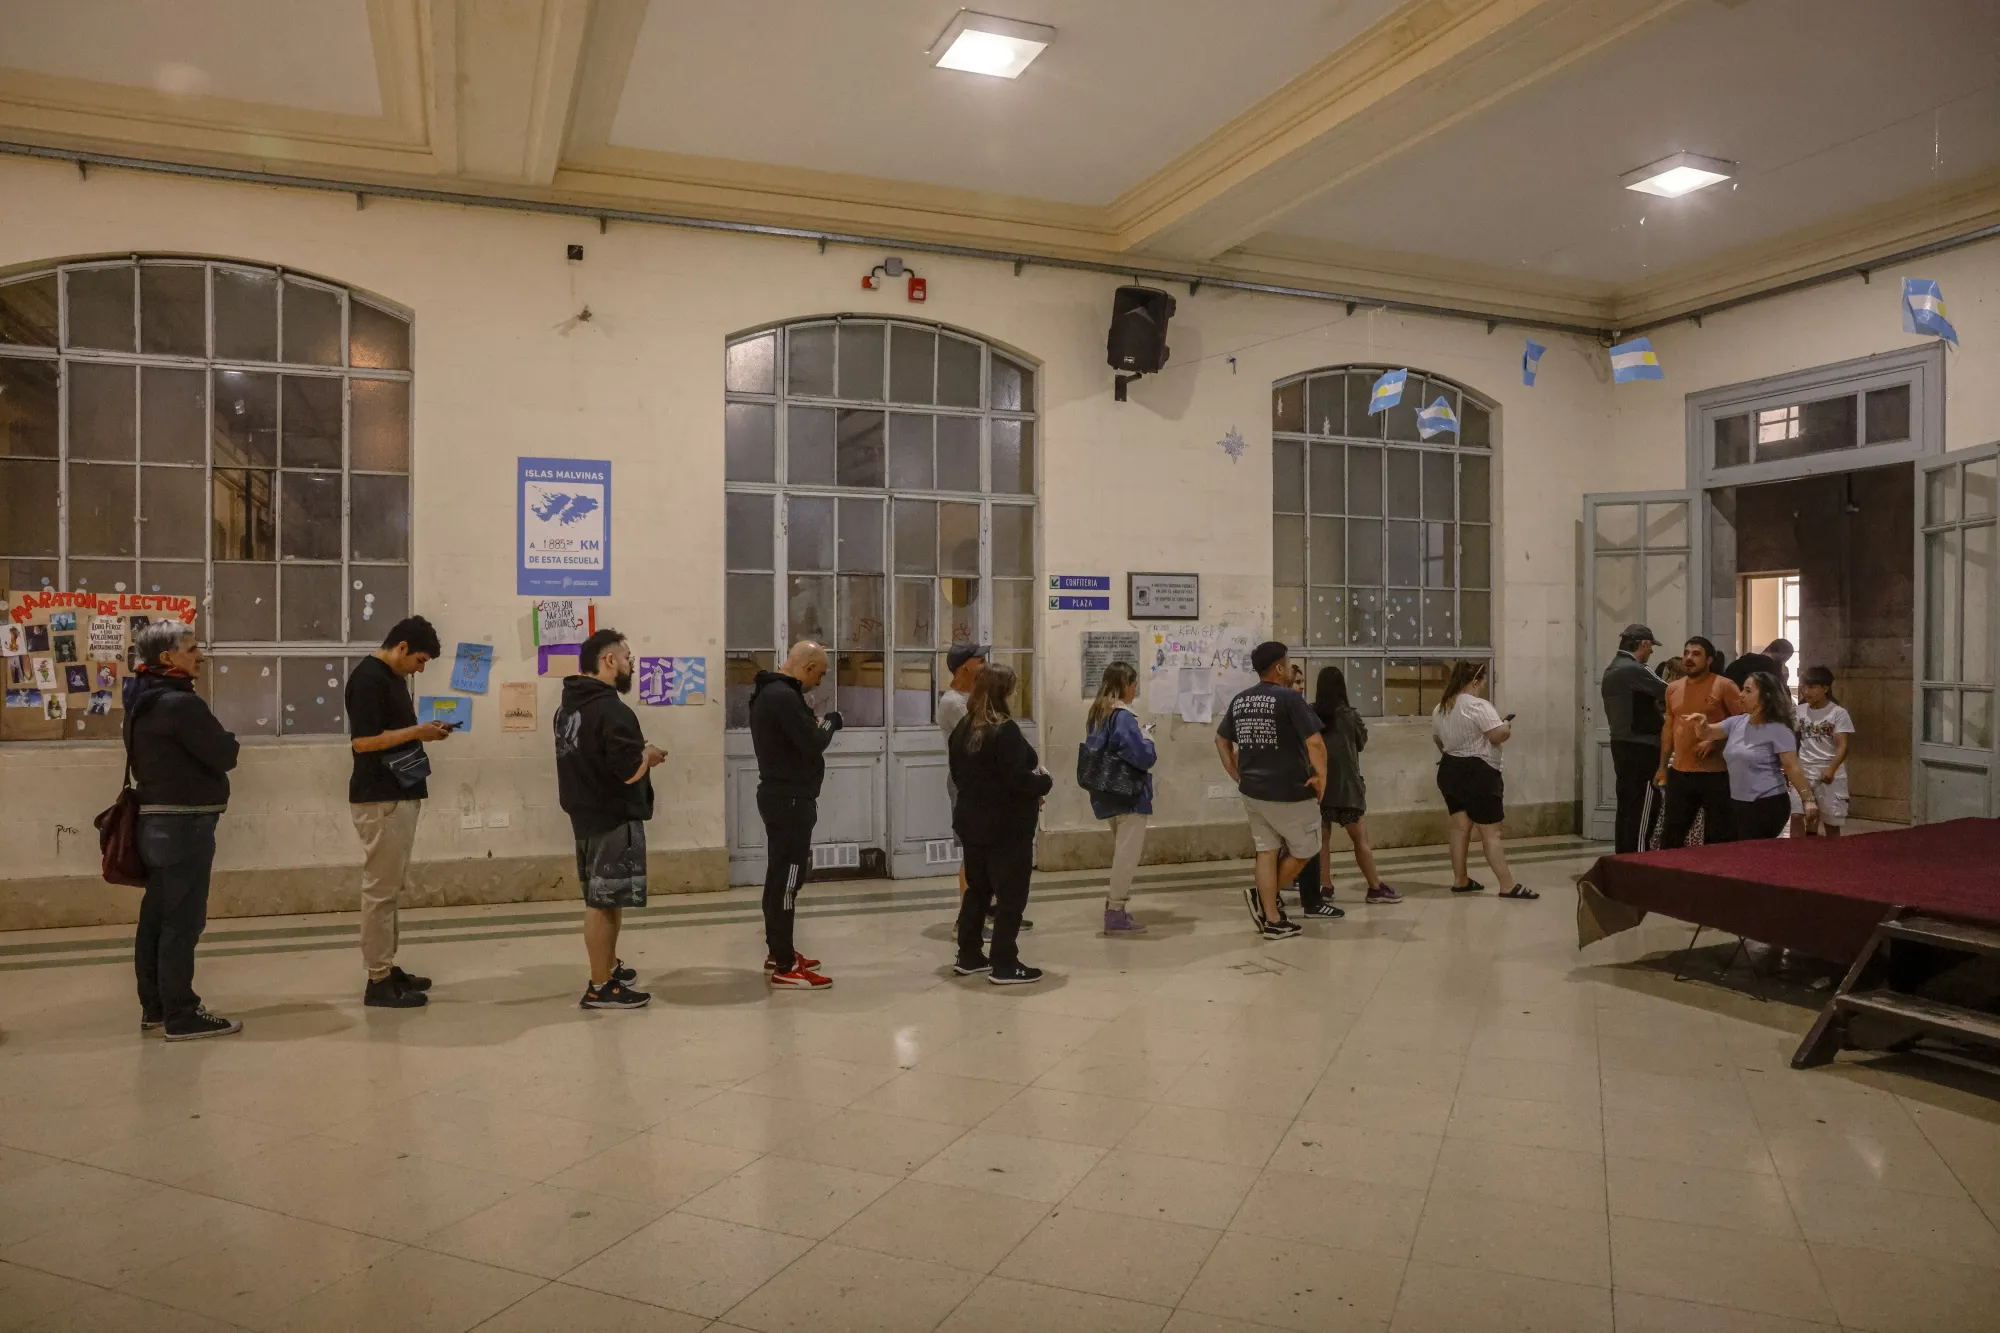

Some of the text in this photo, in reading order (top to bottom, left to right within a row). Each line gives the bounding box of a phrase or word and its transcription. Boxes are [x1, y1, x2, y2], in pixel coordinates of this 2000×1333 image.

[525, 469, 604, 480] ISLAS MALVINAS
[581, 540, 599, 550] KM
[529, 556, 599, 565] DE ESTA ESCUELA
[1065, 578, 1097, 587] CONFITERIA
[10, 591, 197, 624] MARATON DE LECTURA
[1072, 599, 1093, 607] PLAZA
